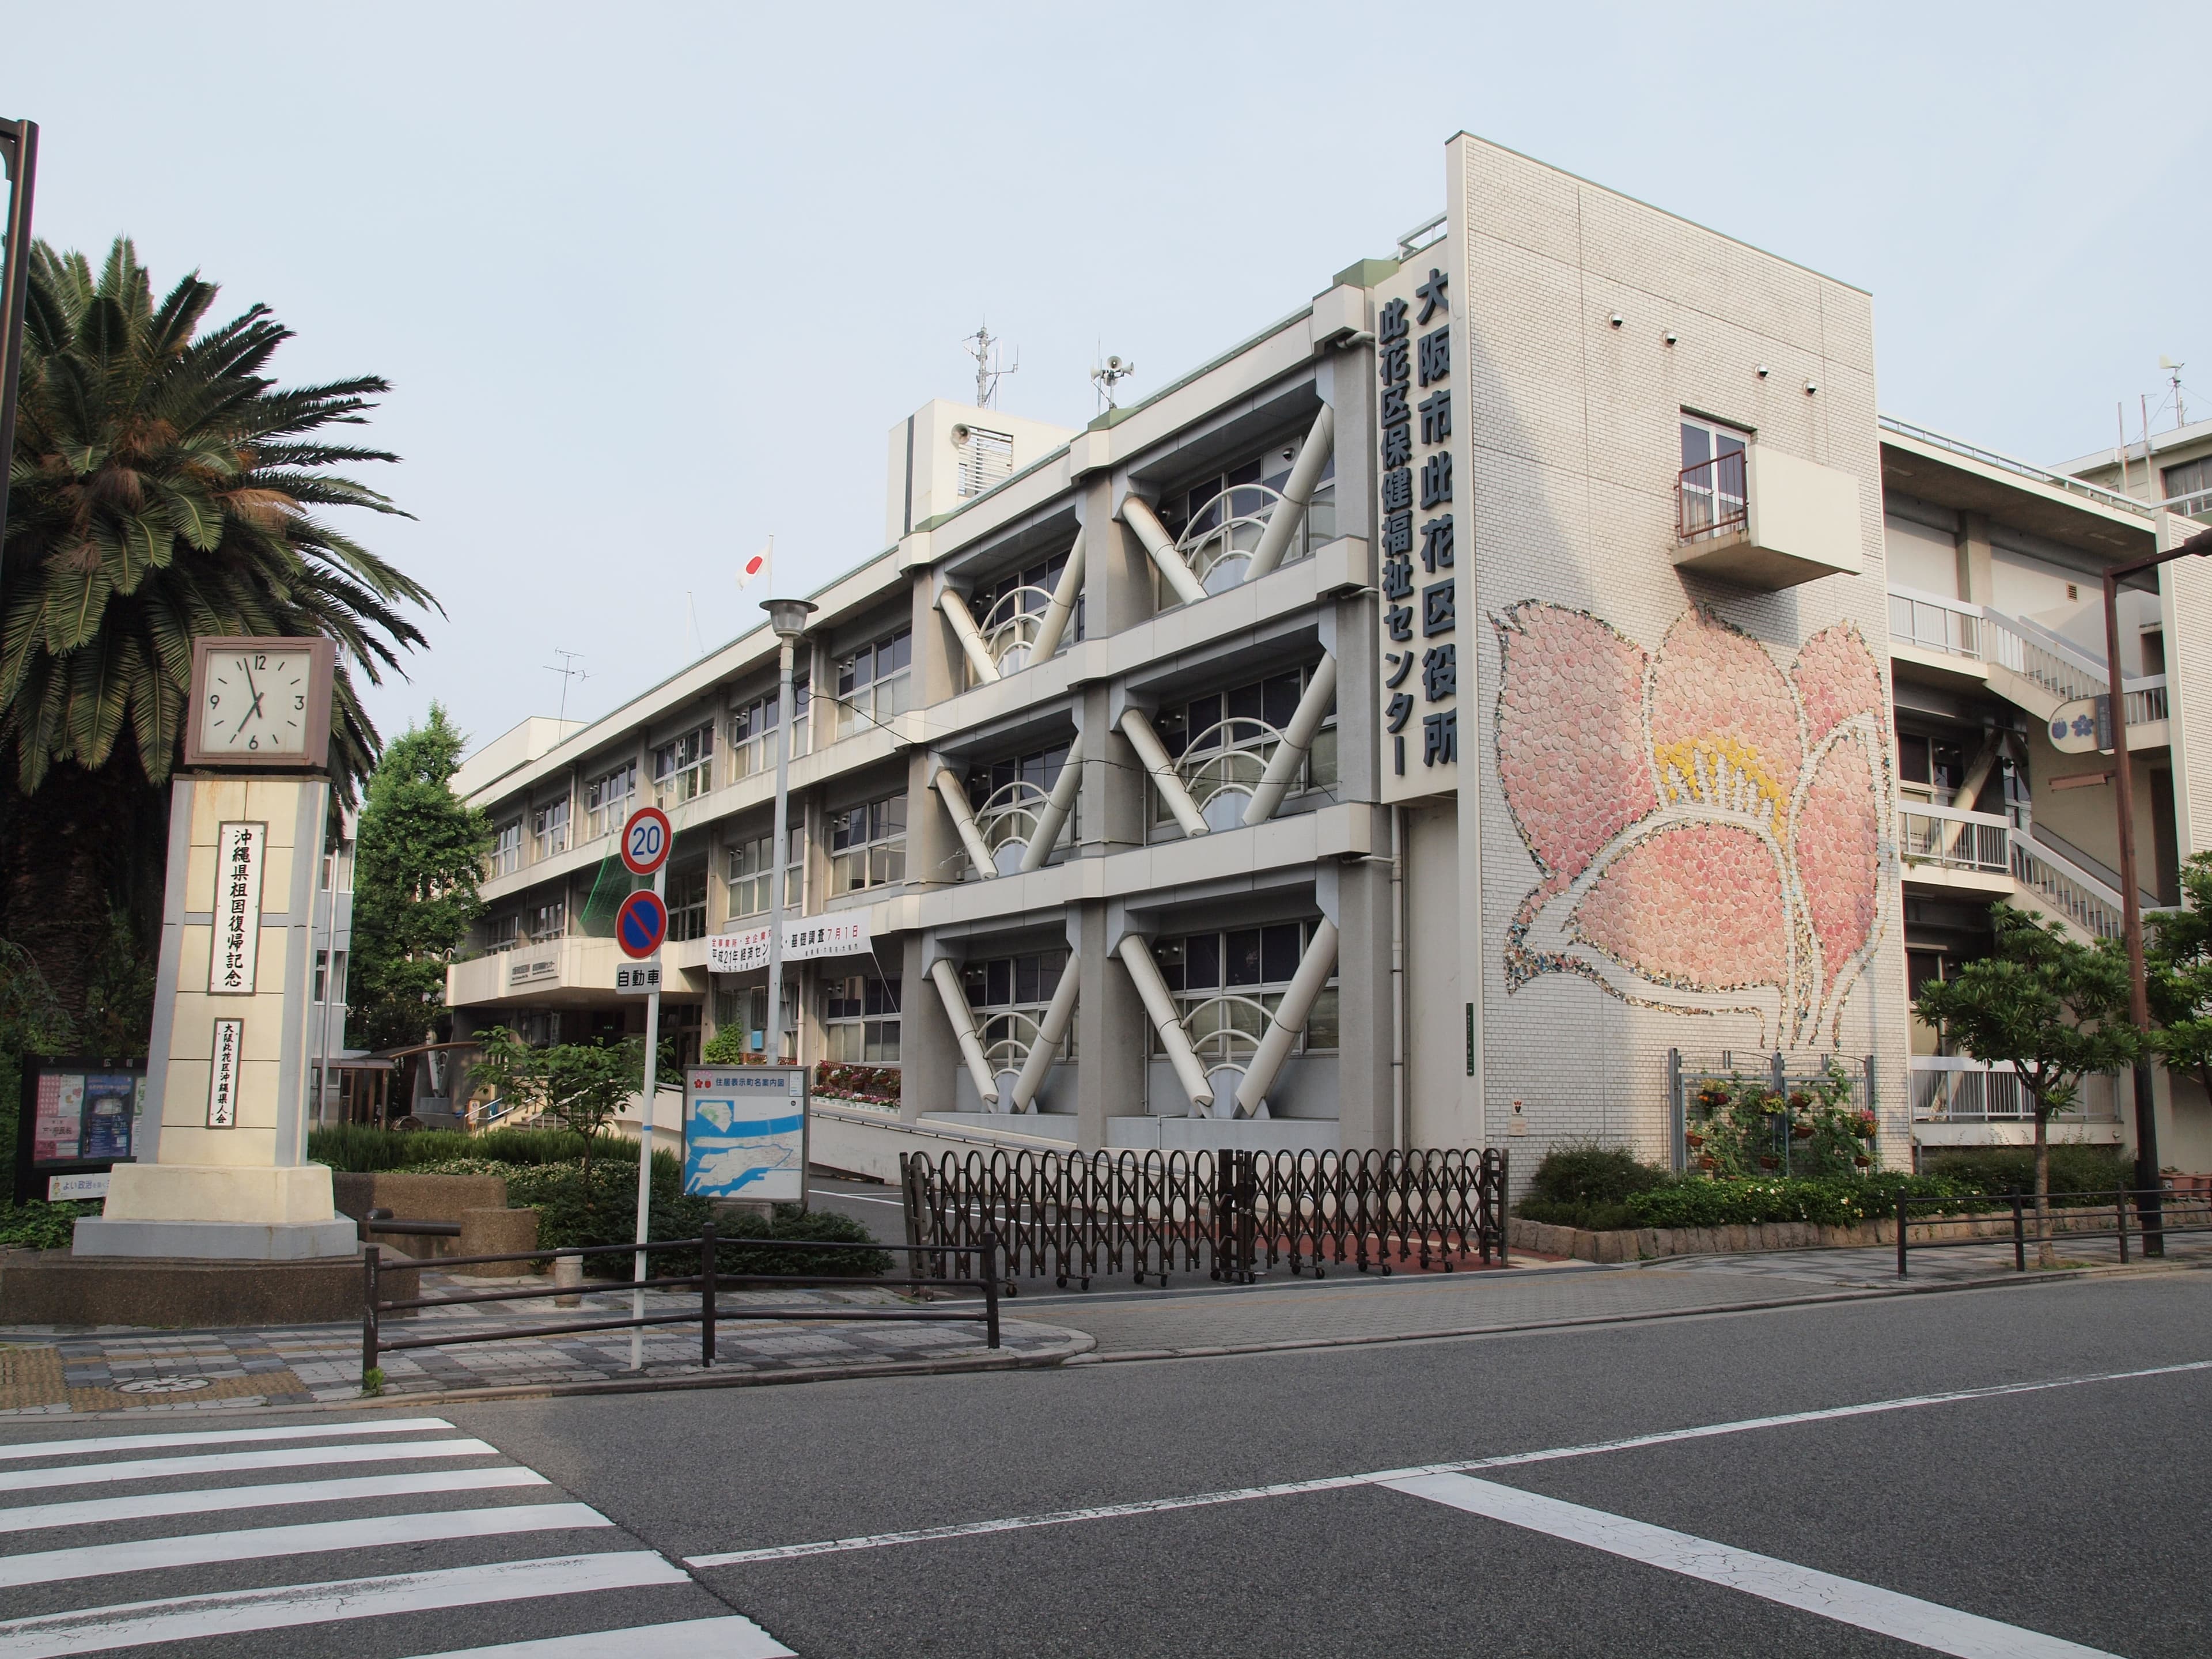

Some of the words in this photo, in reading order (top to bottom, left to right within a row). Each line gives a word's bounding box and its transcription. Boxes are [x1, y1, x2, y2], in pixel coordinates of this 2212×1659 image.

[1416, 267, 1457, 767] 大阪市此花区役所
[1378, 297, 1414, 777] 此花区保健福祉センター
[254, 655, 267, 671] 12
[210, 695, 220, 710] 9
[294, 695, 305, 710] 3
[248, 735, 259, 750] 6
[632, 826, 660, 857] 20
[224, 828, 252, 987] 沖縄県祖国復帰記念
[618, 969, 661, 988] 自動車
[215, 1022, 234, 1124] 大阪此花区沖縄県人会
[716, 1078, 785, 1087] 住居表示町名案内図
